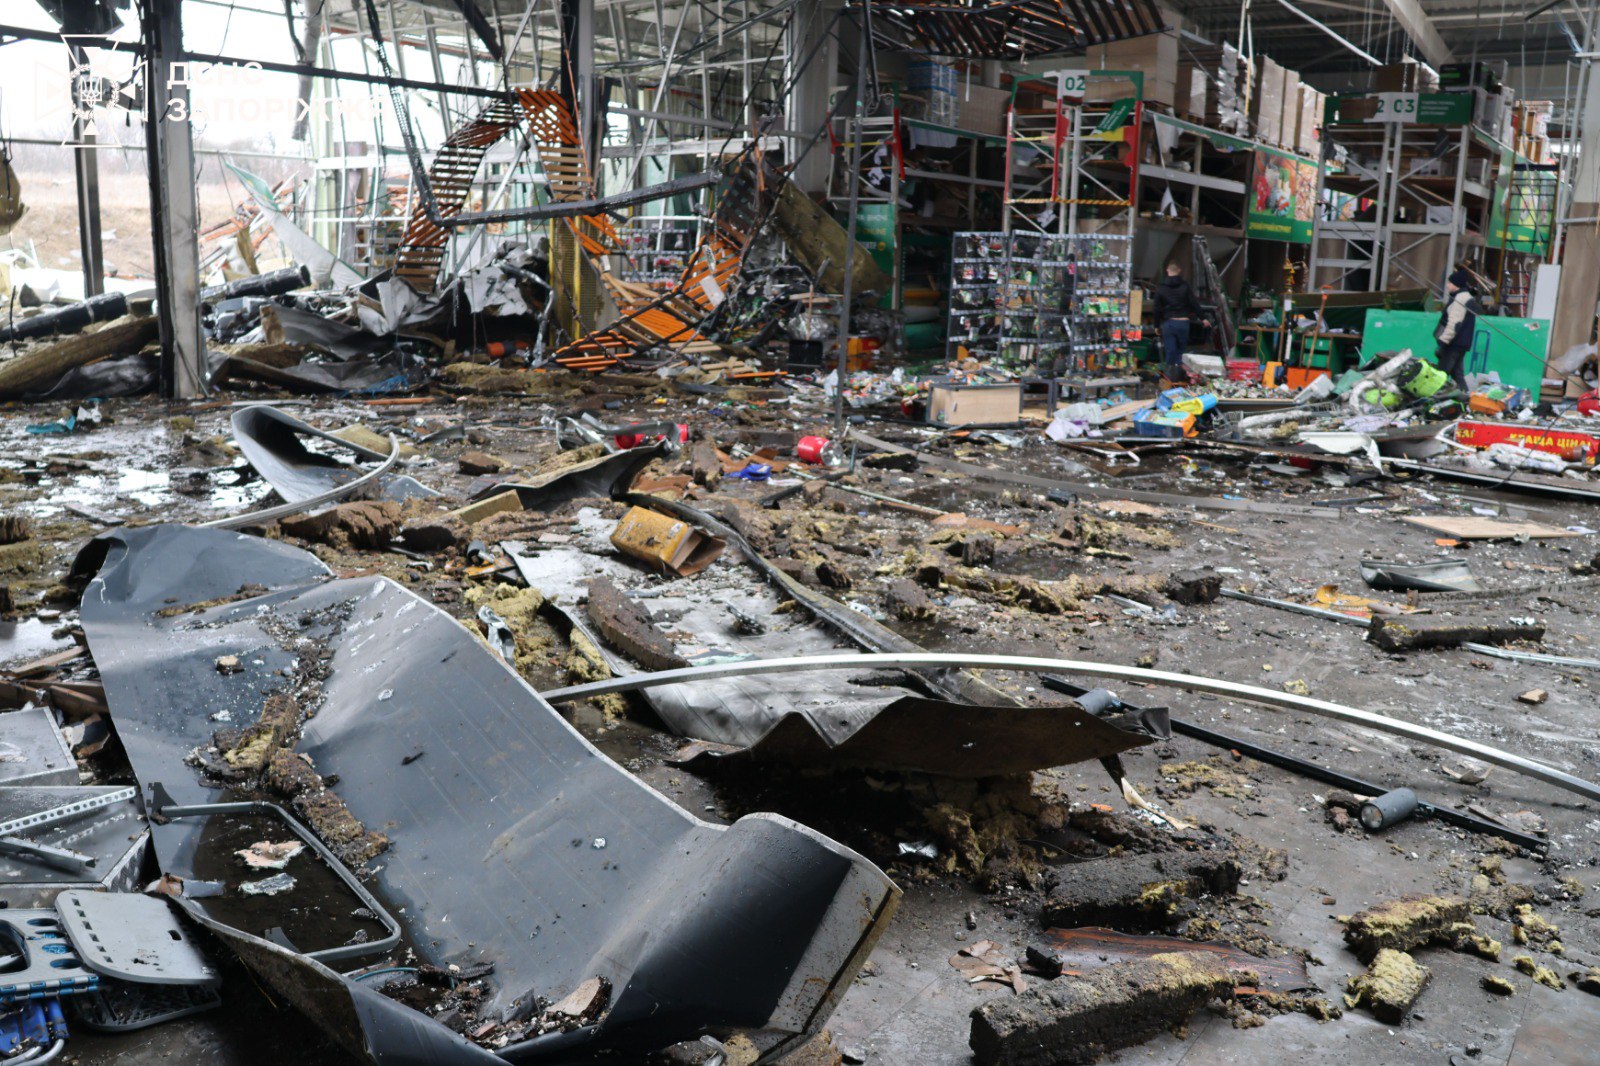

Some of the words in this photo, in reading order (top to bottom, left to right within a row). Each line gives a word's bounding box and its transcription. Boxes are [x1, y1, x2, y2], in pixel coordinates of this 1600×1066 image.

[1065, 77, 1086, 91] 02
[1376, 99, 1385, 113] 2
[1393, 98, 1415, 113] 03
